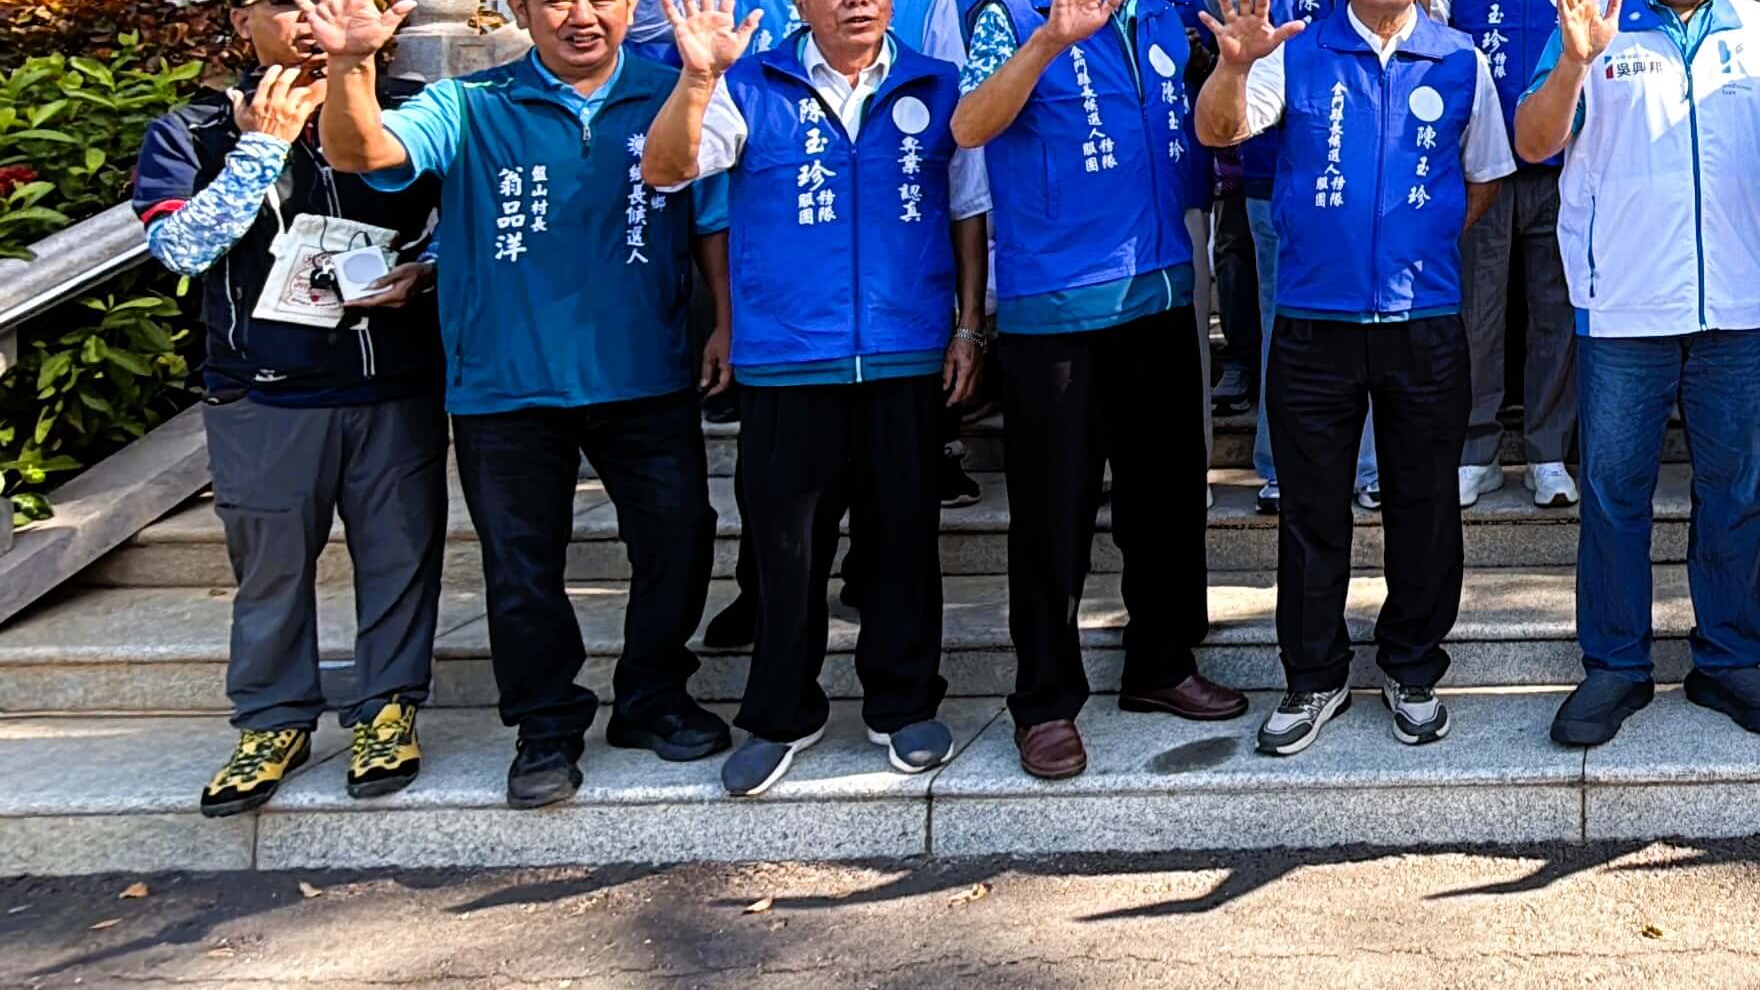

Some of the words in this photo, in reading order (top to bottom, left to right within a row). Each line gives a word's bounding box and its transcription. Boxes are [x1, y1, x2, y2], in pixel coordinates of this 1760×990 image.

[1161, 80, 1184, 162] 陳玉珍
[1408, 125, 1436, 209] 陳玉珍
[495, 167, 527, 262] 翁品洋
